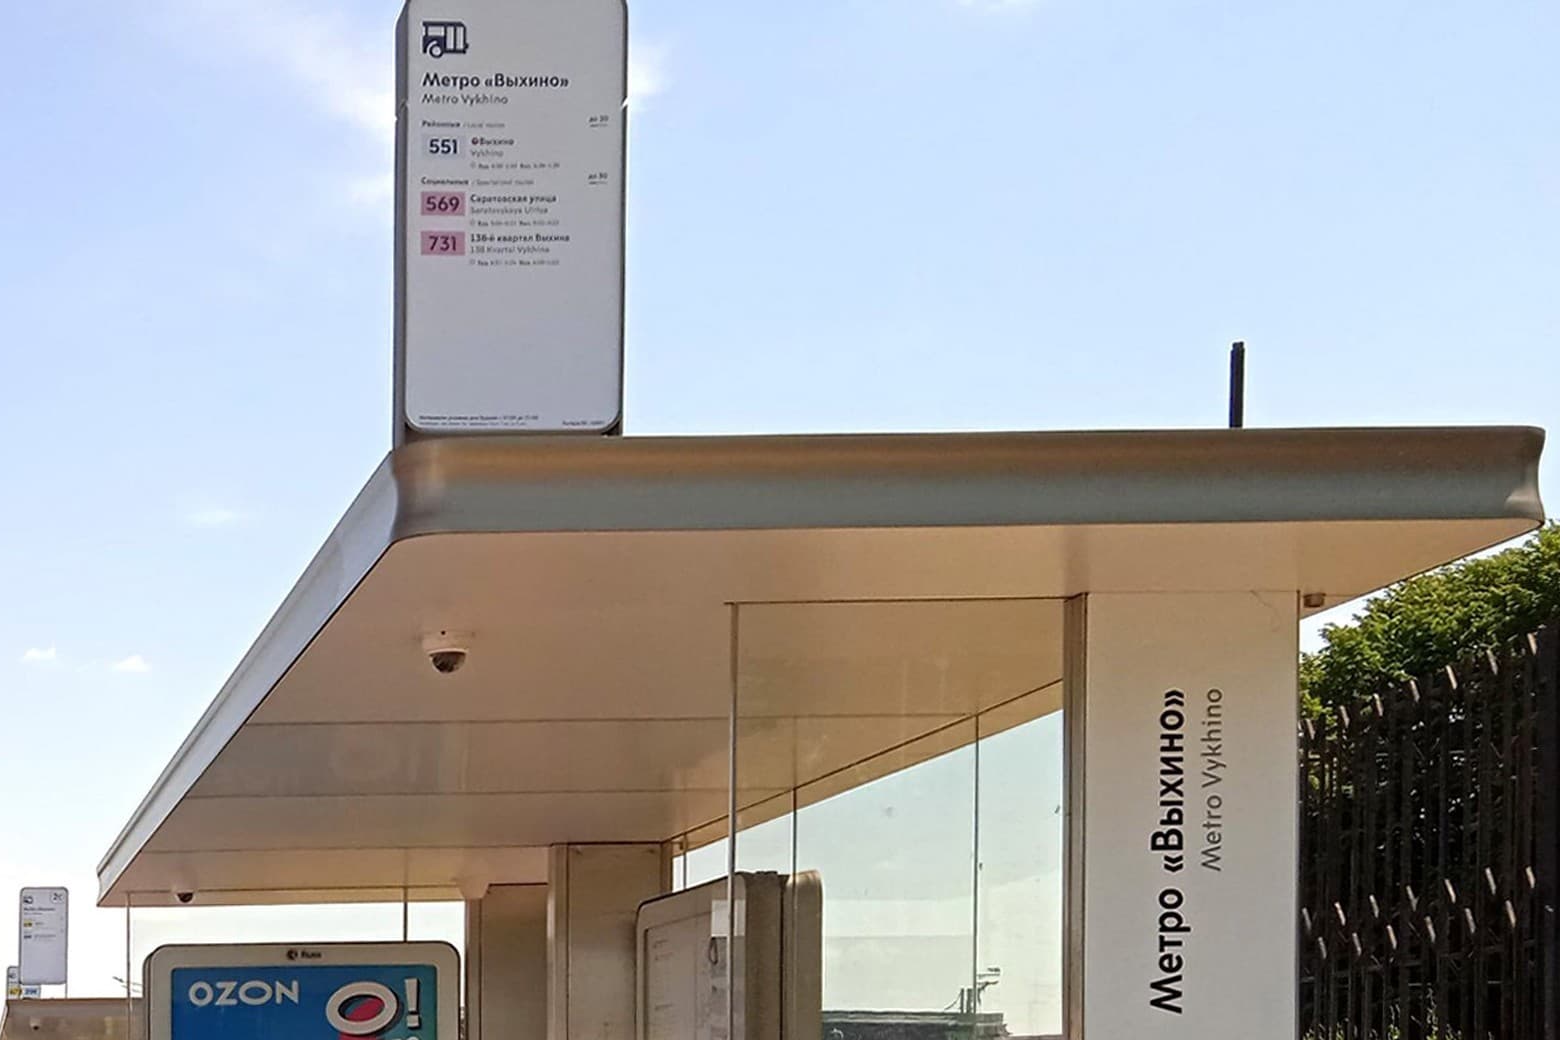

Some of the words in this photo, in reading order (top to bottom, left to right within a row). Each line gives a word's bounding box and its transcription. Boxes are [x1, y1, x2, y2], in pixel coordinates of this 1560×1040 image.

[422, 73, 481, 90] Метро
[485, 73, 569, 88] «Выхино»
[422, 94, 458, 104] Metro
[461, 93, 508, 107] Vykhino
[429, 139, 458, 154] 551
[426, 196, 460, 211] 569
[429, 236, 457, 251] 731
[1201, 687, 1227, 789] Vykhino
[1150, 688, 1185, 873] «Выхино»
[1201, 795, 1223, 872] Metro
[1150, 888, 1192, 1014] Метро
[189, 980, 300, 1006] OZON
